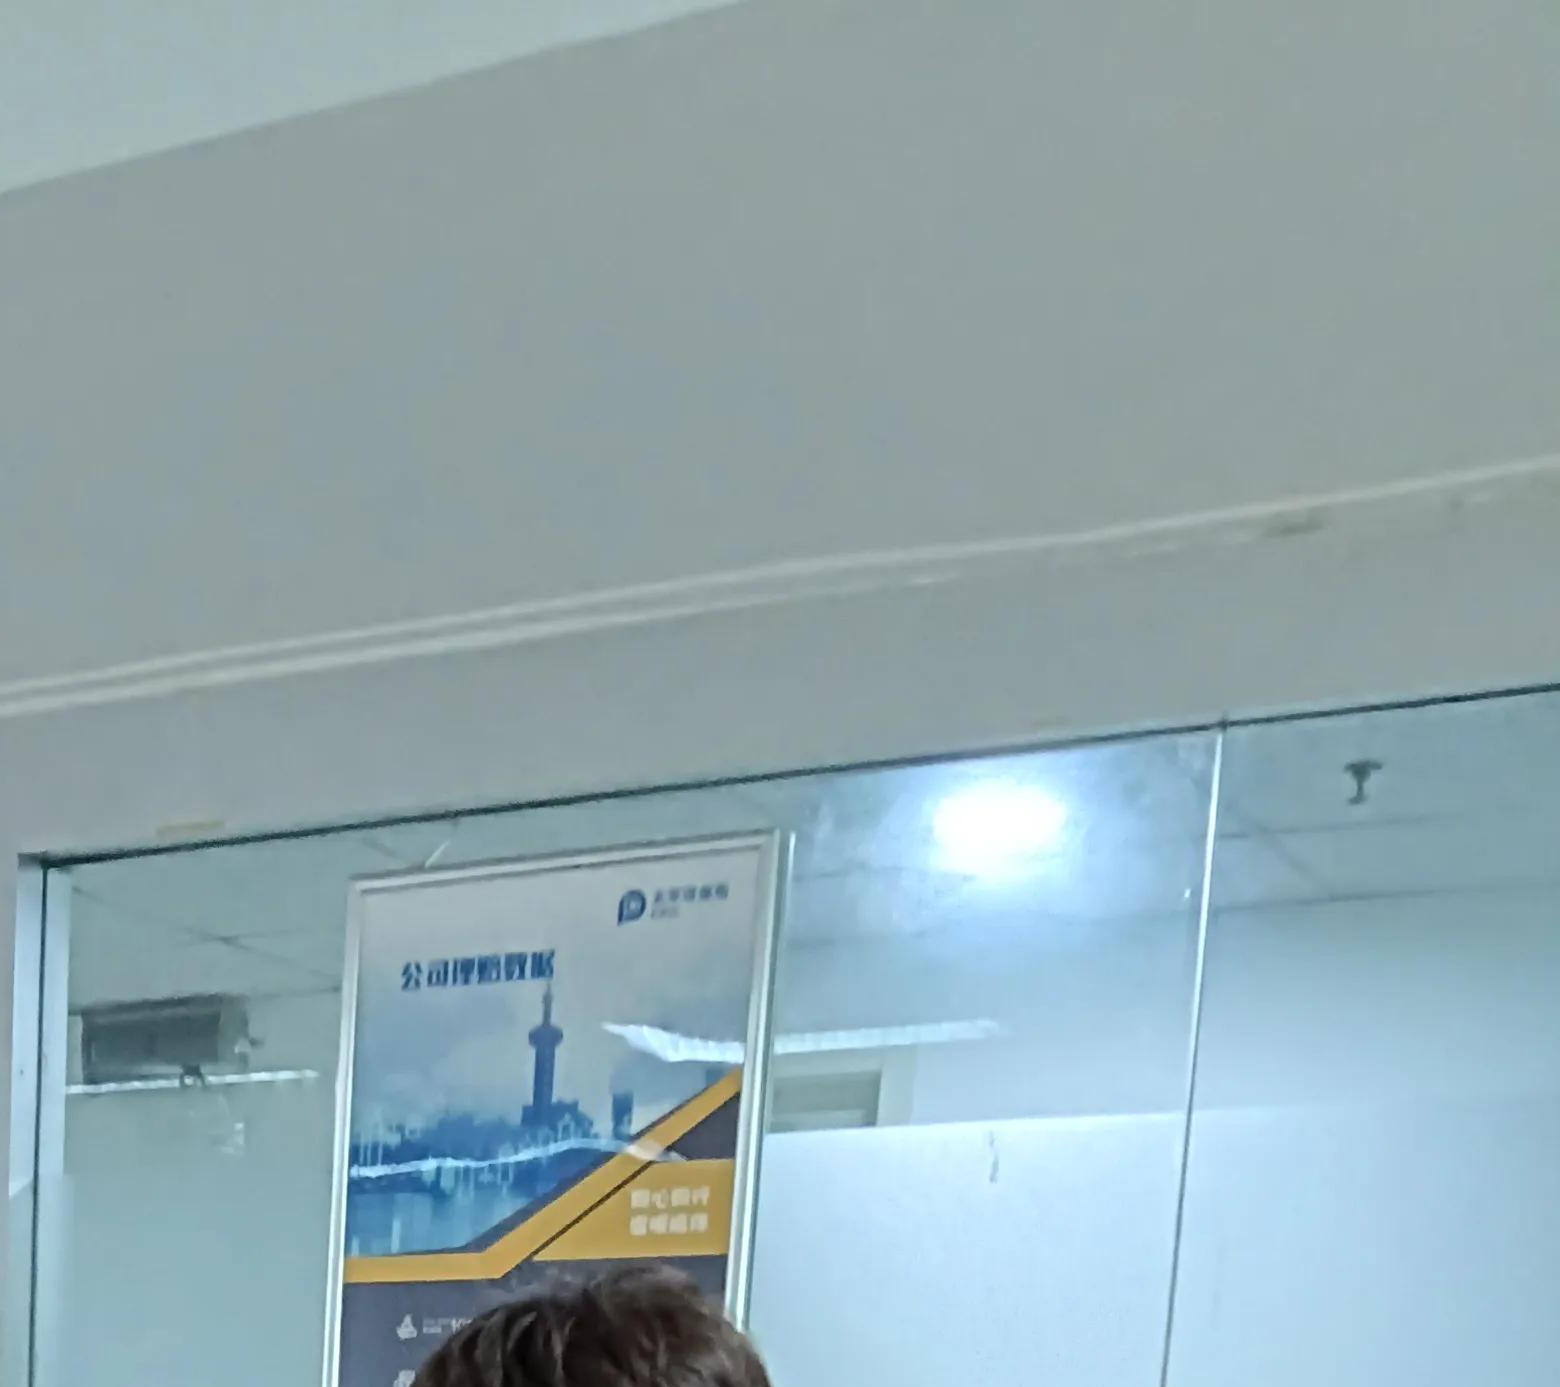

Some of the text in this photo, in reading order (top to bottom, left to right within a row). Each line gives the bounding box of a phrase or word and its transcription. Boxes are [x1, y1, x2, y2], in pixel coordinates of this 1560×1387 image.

[401, 949, 555, 991] 公司理赔数据
